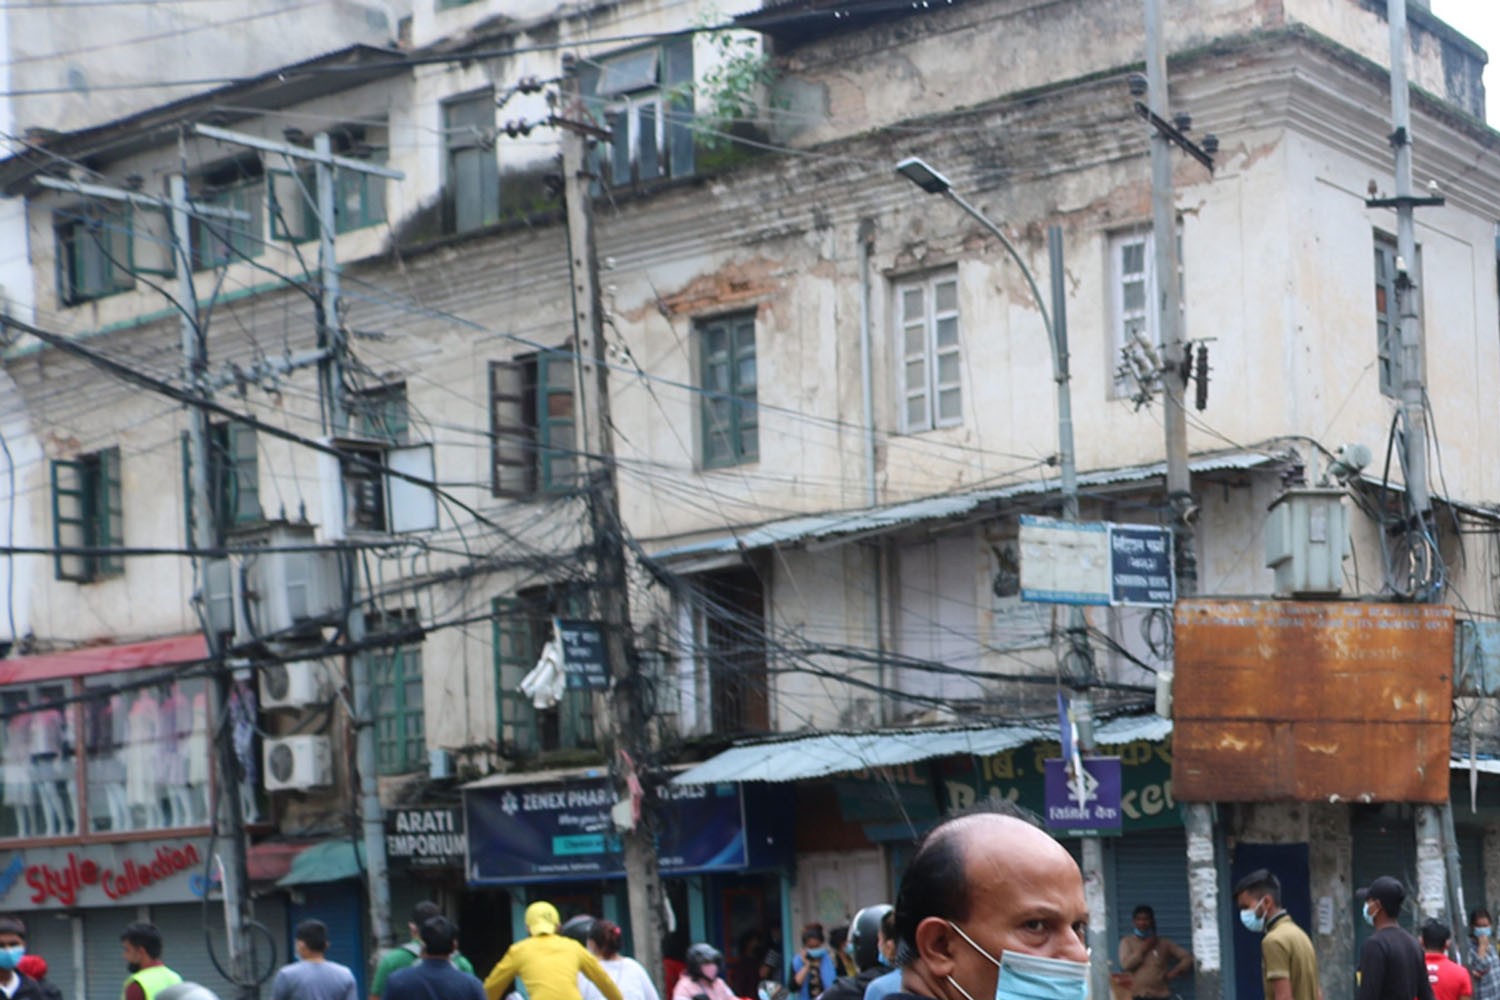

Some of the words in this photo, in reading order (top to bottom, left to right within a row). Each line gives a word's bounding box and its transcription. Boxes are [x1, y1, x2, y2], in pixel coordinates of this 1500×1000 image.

[522, 793, 566, 811] ZENEX
[395, 810, 455, 833] ARATI
[386, 832, 466, 857] EMPORIUM
[25, 852, 99, 906] Style
[101, 842, 201, 901] Collection
